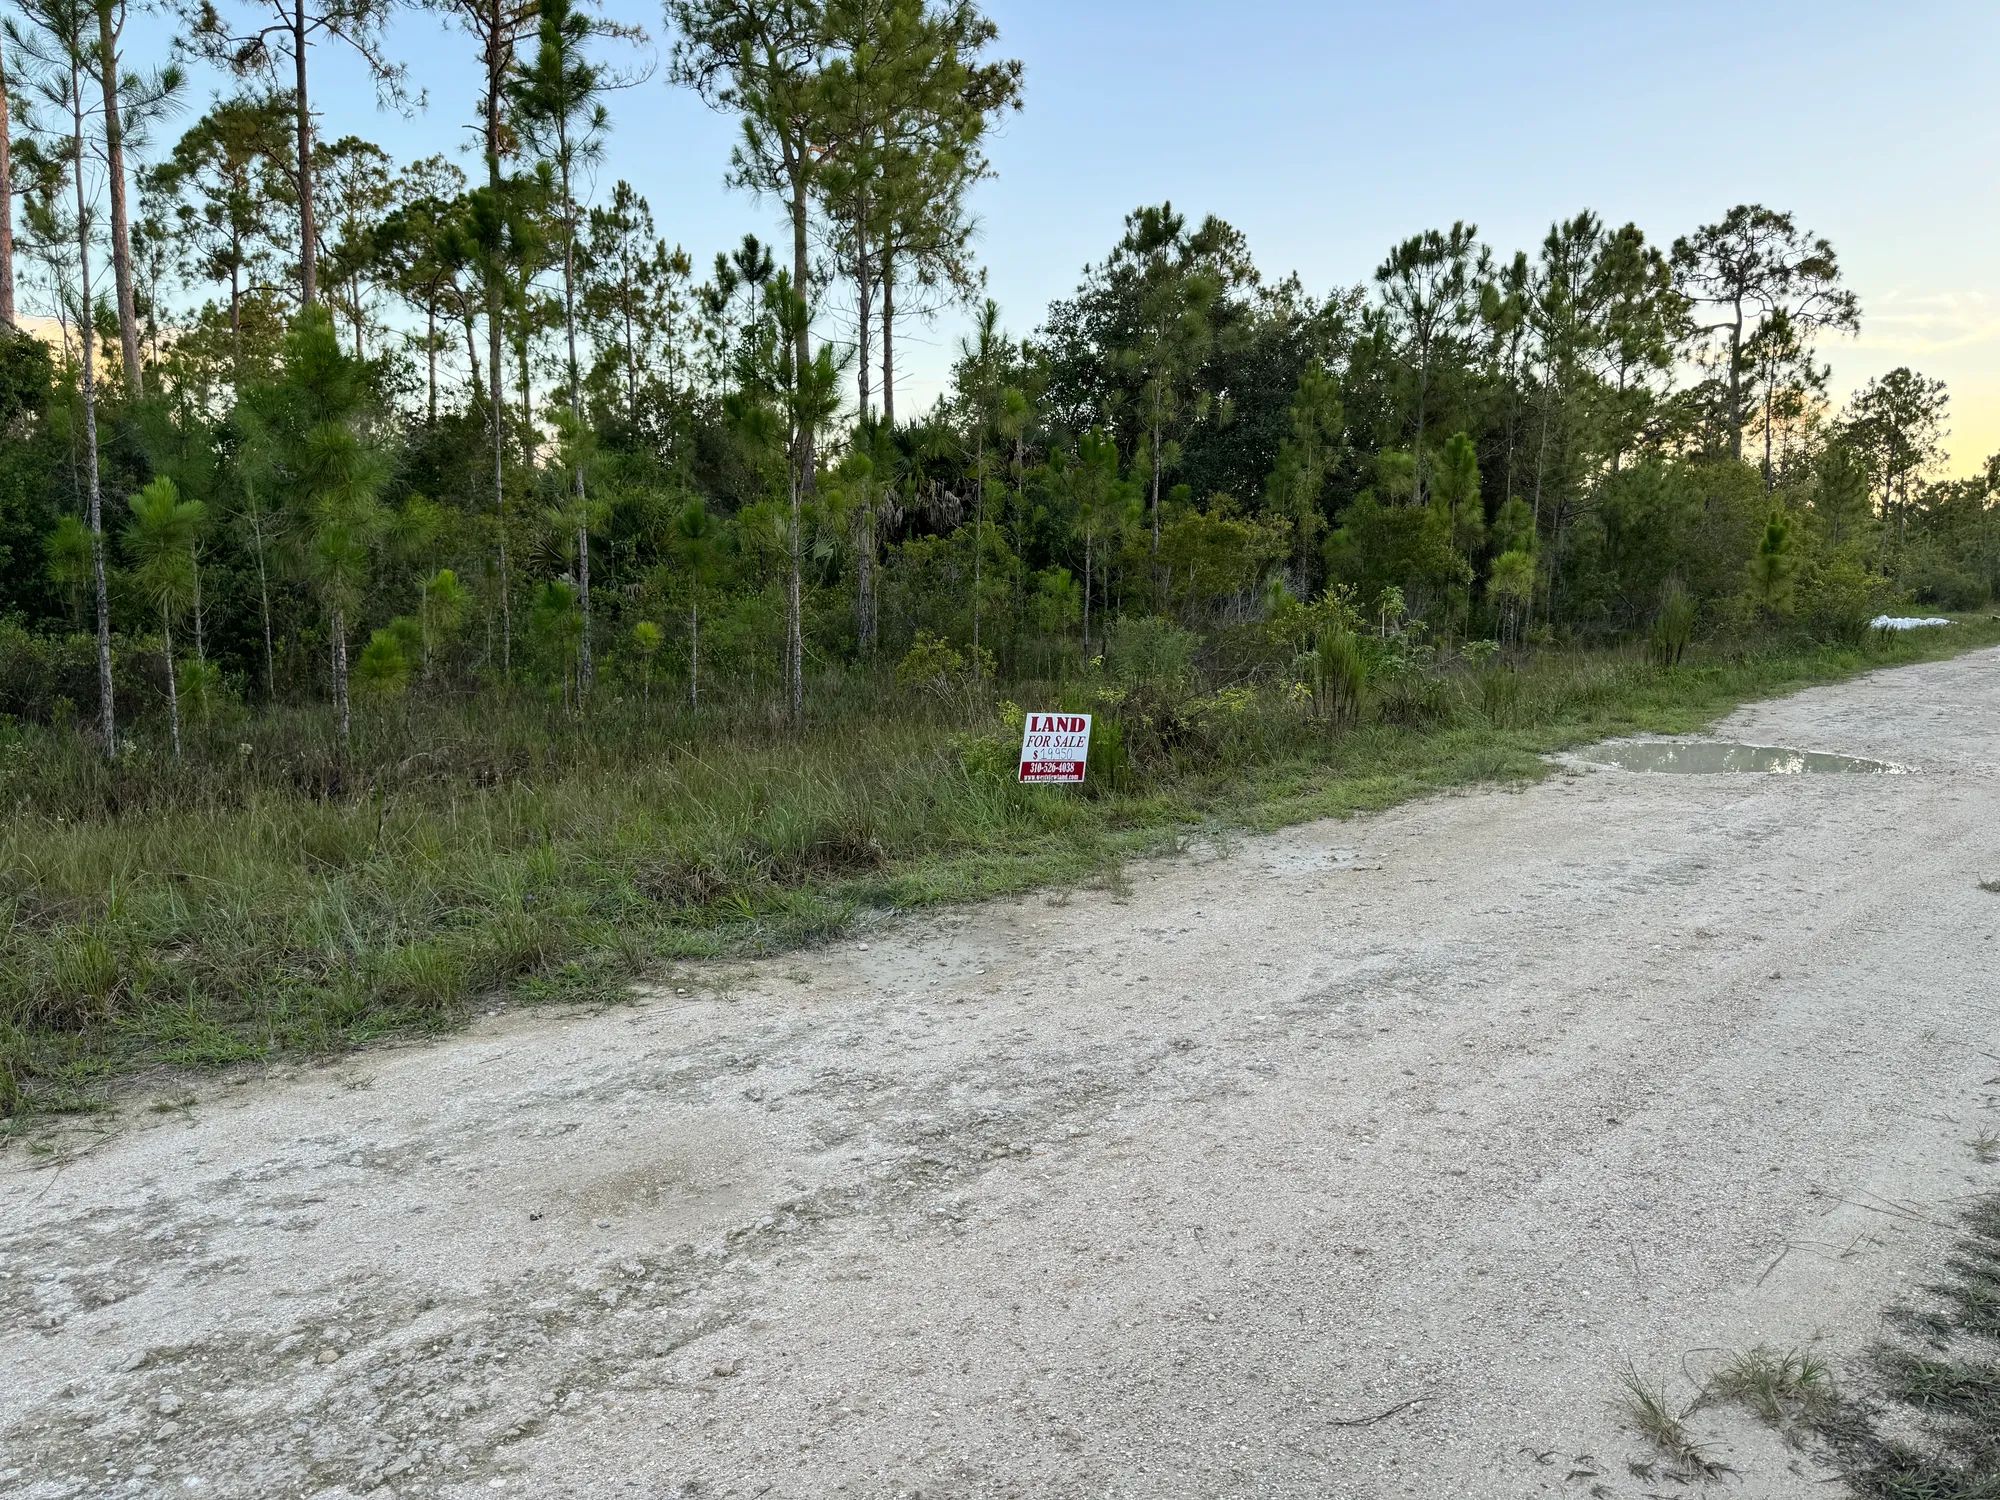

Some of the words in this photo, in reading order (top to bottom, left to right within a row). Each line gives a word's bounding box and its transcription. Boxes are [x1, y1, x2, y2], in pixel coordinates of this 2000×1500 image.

[1030, 716, 1085, 732] LAND
[1026, 735, 1051, 747] FOR
[1053, 735, 1086, 747] SALE
[1029, 762, 1075, 773] 310-526-4038
